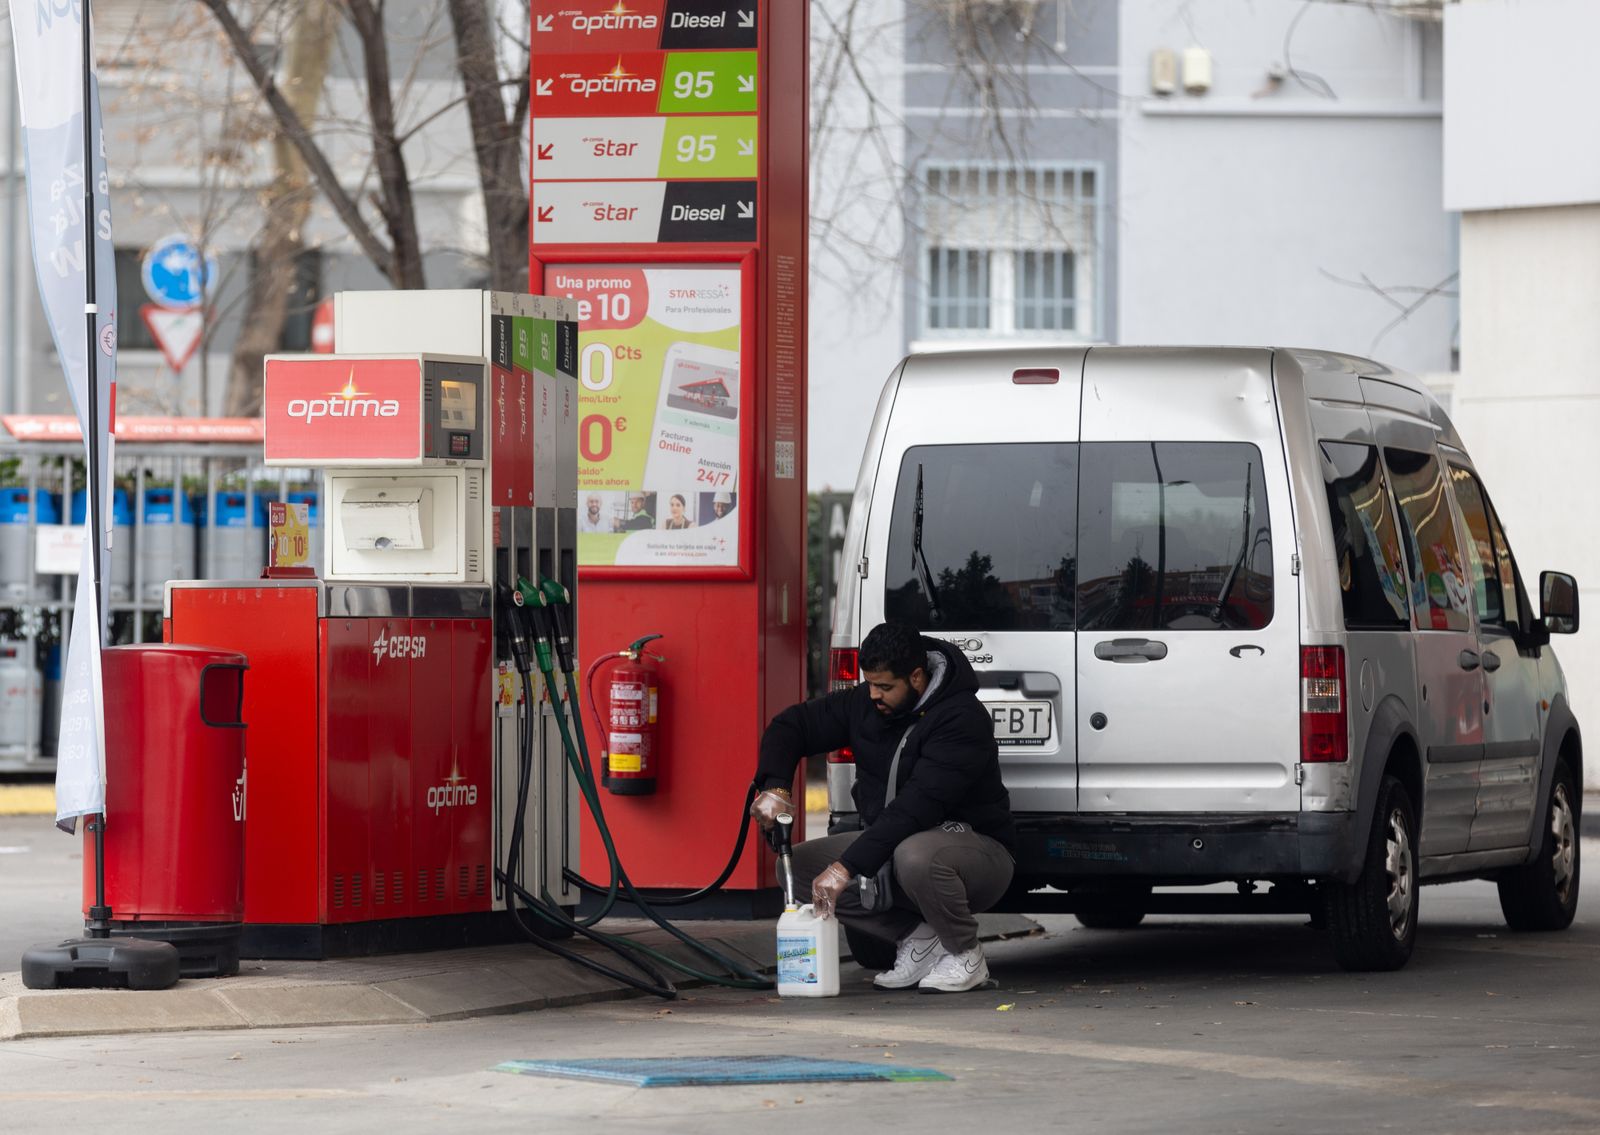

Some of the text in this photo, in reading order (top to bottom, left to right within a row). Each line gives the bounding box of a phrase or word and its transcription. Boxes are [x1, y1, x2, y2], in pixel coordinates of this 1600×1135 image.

[572, 12, 726, 35] optima Diesel
[570, 71, 715, 98] optima 95
[593, 135, 717, 162] star 95
[593, 204, 726, 221] star Diesel
[556, 276, 631, 292] Una promo
[597, 293, 631, 321] 10
[683, 305, 732, 314] Profesionales
[519, 328, 527, 357] 95
[541, 332, 548, 361] 95
[615, 344, 642, 360] Cts
[287, 395, 399, 424] optima
[658, 439, 692, 455] Online
[660, 430, 693, 443] Facturas
[697, 458, 731, 471] Atención
[605, 478, 630, 486] ahora
[696, 468, 729, 485] 24/7
[294, 535, 304, 557] 10
[389, 636, 426, 658] CEPSA
[427, 783, 477, 816] optima
